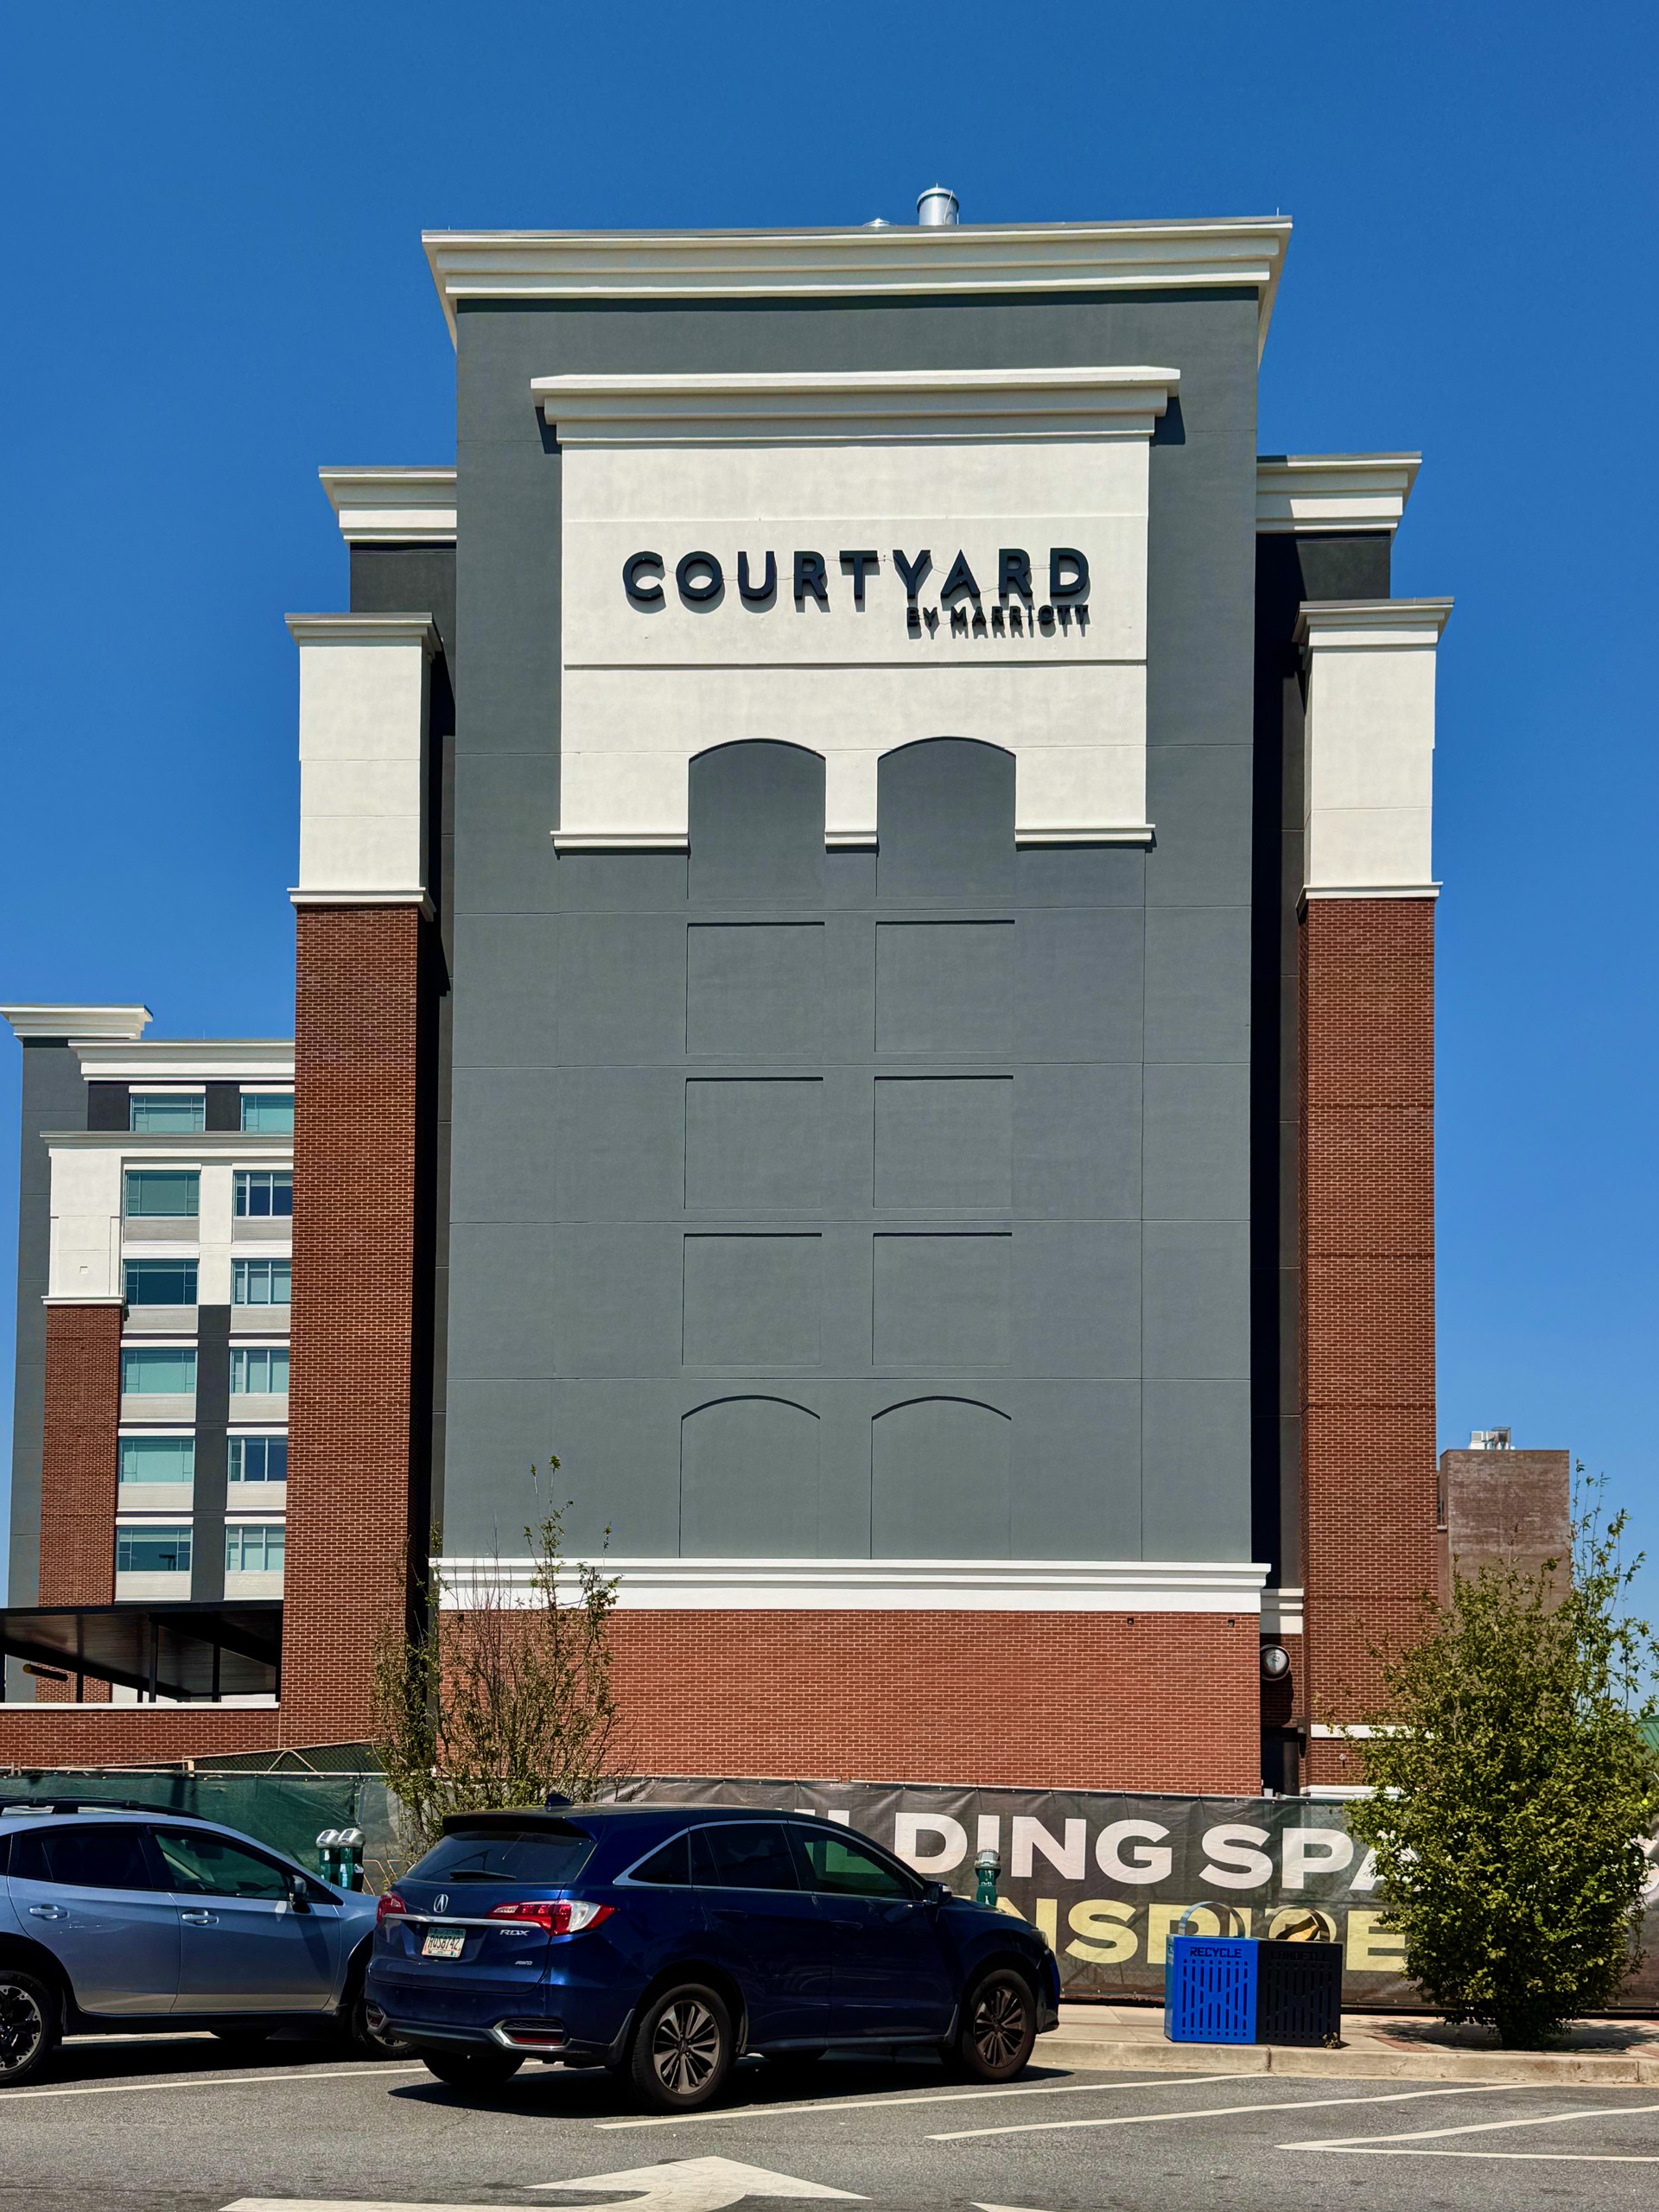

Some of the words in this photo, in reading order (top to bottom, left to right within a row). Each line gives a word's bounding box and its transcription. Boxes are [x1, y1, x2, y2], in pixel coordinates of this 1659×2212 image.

[622, 548, 1090, 601] COURTYARD
[906, 607, 938, 627] BY
[951, 605, 1089, 626] MARRIOTT
[1189, 1946, 1243, 1959] RECYCLE
